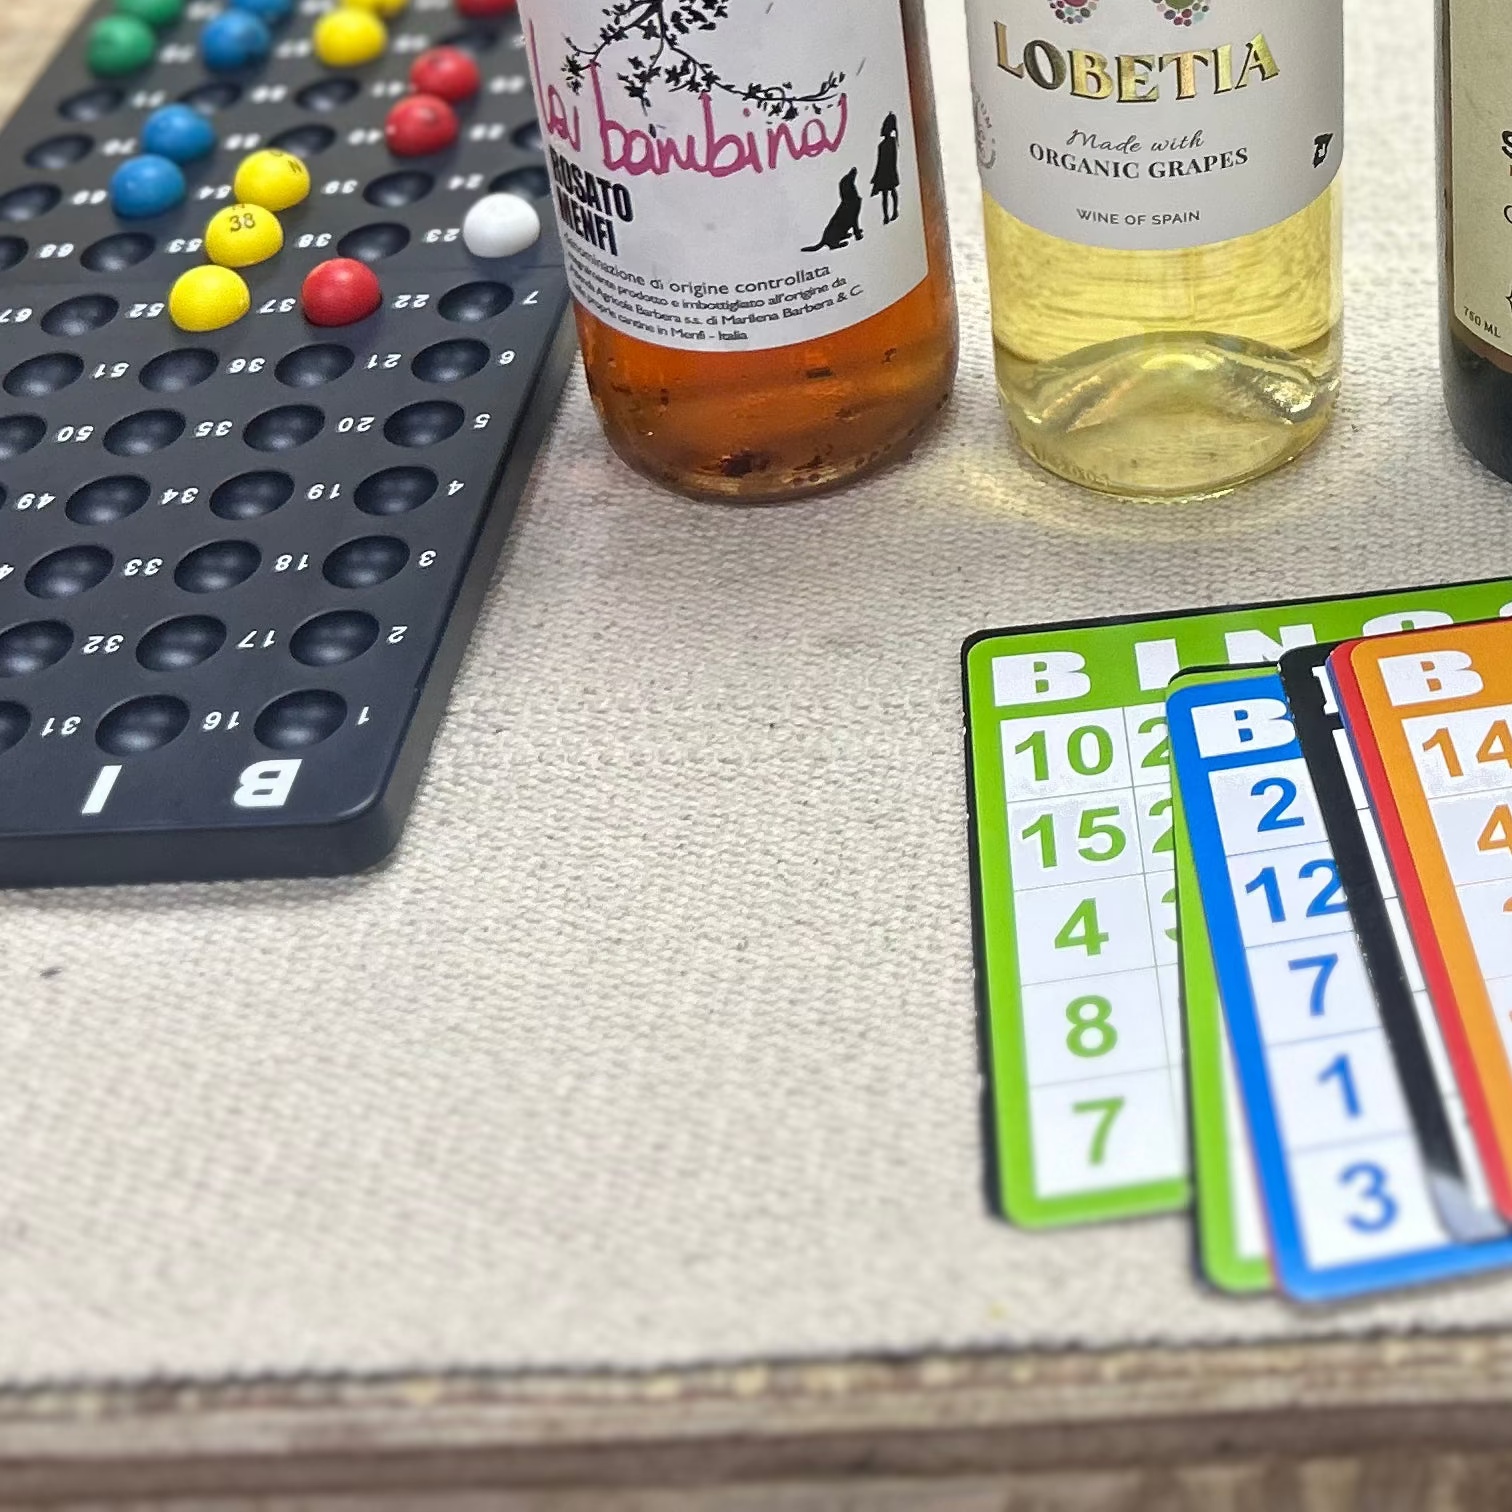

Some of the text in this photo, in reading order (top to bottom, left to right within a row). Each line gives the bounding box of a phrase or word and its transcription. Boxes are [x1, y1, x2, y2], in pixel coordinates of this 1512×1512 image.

[994, 20, 1280, 103] LOBETIA
[589, 60, 849, 178] bambina
[1066, 127, 1205, 155] Made with
[1029, 142, 1249, 179] ORGANIC GRAPES
[550, 143, 635, 223] ROSATO
[229, 212, 255, 233] 38
[556, 187, 619, 257] MENFI
[1075, 208, 1200, 226] WINE OF SPAIN
[168, 238, 203, 254] 53
[426, 227, 460, 243] 23
[650, 278, 664, 291] di
[669, 279, 729, 299] origine
[735, 265, 831, 294] controllata
[831, 275, 847, 289] da
[128, 302, 165, 318] 52
[259, 298, 296, 314] 37
[393, 293, 430, 309] 22
[522, 291, 538, 305] 7
[706, 314, 718, 326] di
[782, 297, 835, 319] Barbera
[836, 291, 849, 303] &
[1484, 321, 1501, 338] ML
[92, 361, 130, 379] 51
[228, 357, 266, 374] 36
[366, 353, 401, 369] 21
[56, 413, 491, 442] 5 20 35 50
[17, 480, 464, 510] 4 19 34 49
[123, 549, 437, 576] 3 18 33
[82, 625, 407, 654] 2 17 32
[40, 705, 370, 736] 1 16 31
[1014, 724, 1114, 781] 10
[1249, 777, 1305, 833] 2
[1021, 806, 1127, 869] 15
[1245, 858, 1348, 924] 12
[1054, 898, 1109, 956] 4
[1288, 952, 1339, 1017] 7
[1065, 995, 1118, 1058] 8
[1316, 1051, 1364, 1120] 1
[1071, 1096, 1126, 1166] 7
[1337, 1160, 1399, 1234] 3
